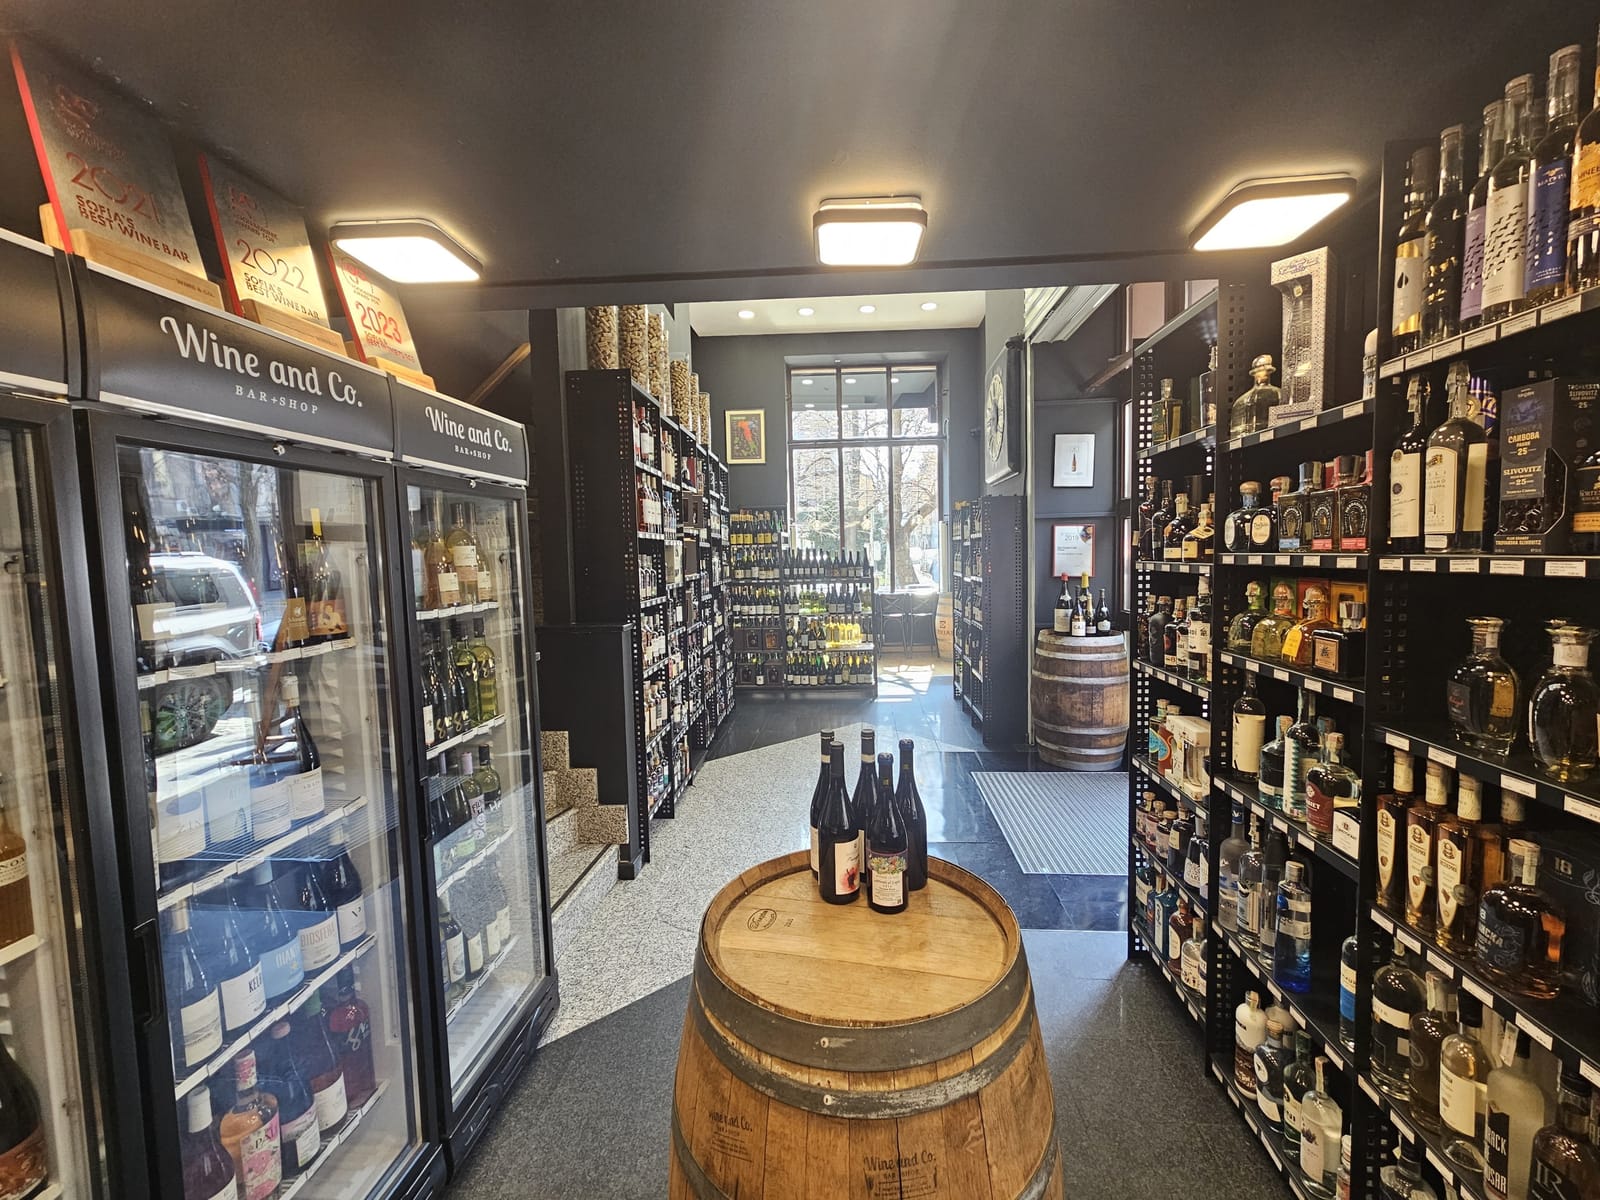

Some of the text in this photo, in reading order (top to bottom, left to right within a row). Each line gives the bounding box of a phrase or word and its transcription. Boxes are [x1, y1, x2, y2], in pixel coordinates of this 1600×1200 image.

[66, 152, 161, 224] 2021
[75, 194, 136, 229] SOFIA'S
[78, 206, 114, 230] BEST
[236, 238, 309, 294] 2022
[356, 301, 402, 344] 2023
[160, 316, 363, 407] Wine and Co.
[425, 406, 512, 453] Wine and Co.
[1503, 465, 1542, 476] SLIVOVITZ
[1517, 447, 1528, 456] 25
[863, 1155, 894, 1171] Wine
[921, 1150, 937, 1165] Co.
